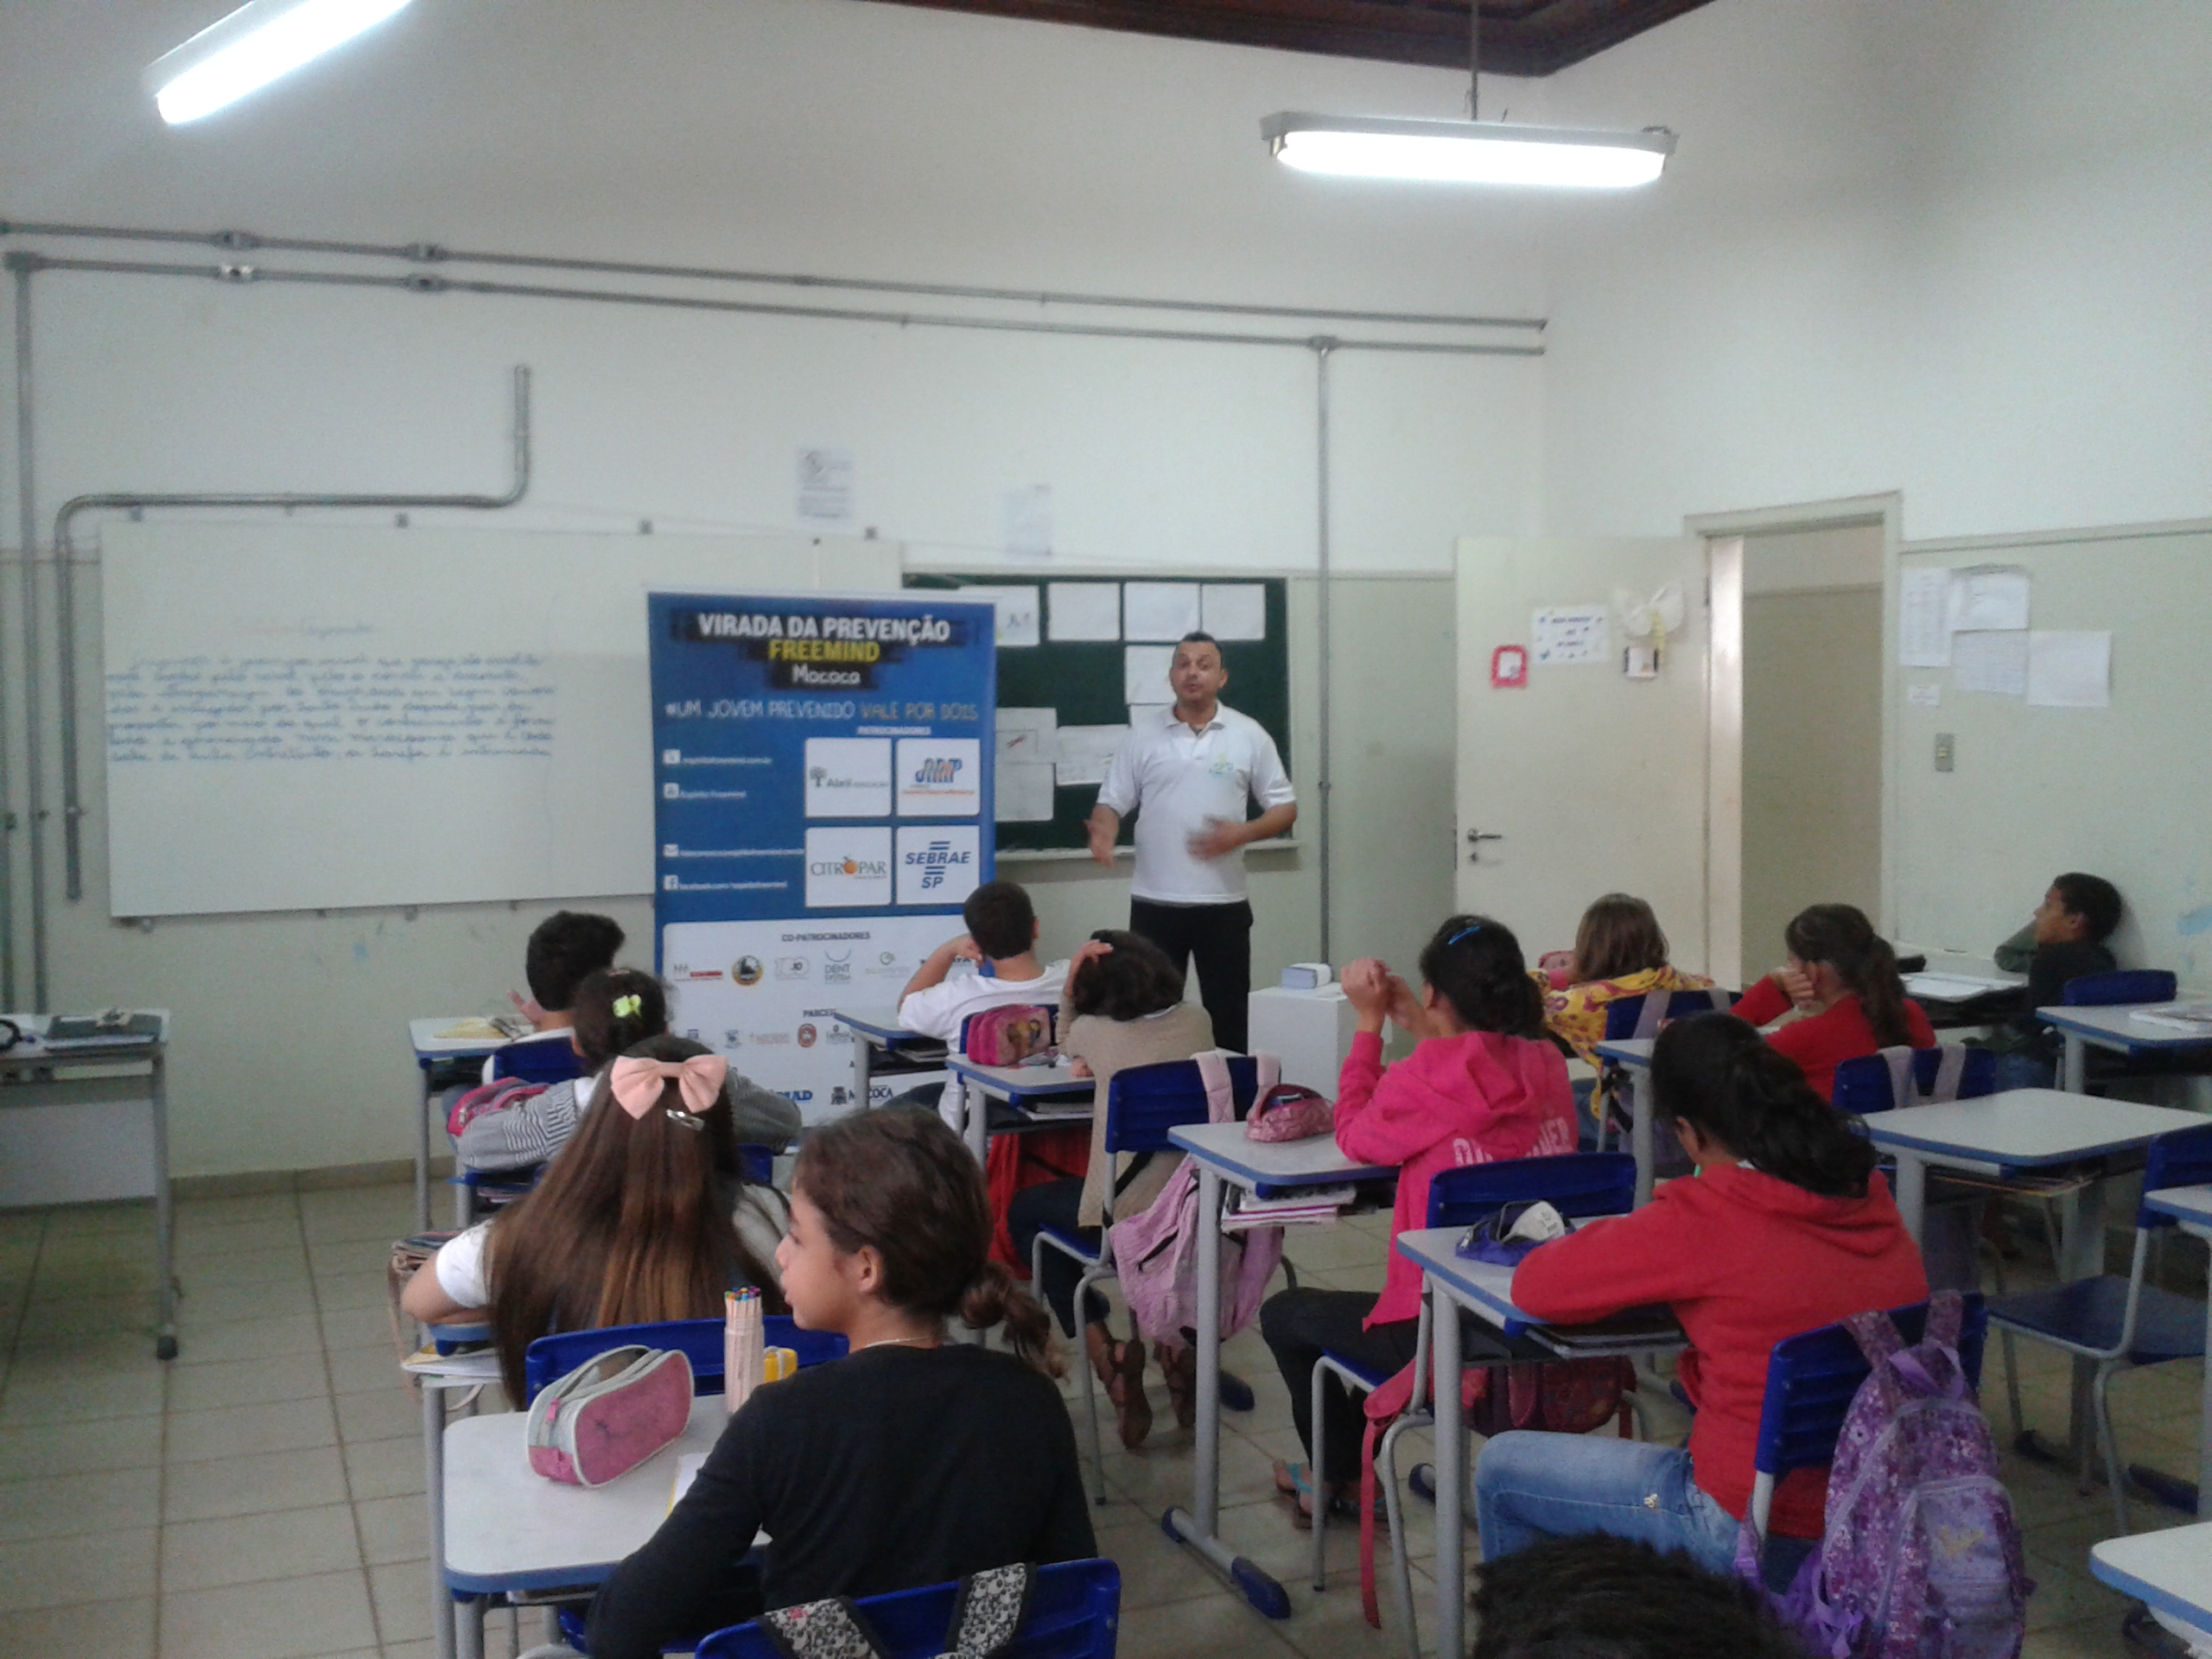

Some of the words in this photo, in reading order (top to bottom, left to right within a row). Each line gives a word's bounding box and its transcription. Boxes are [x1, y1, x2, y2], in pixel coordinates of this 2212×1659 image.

[698, 612, 783, 638] VIRADA
[787, 616, 819, 638] DA
[823, 614, 950, 646] PREVENÇÃO
[768, 639, 880, 663] FREEMIND
[708, 699, 764, 719] JOVEM
[768, 701, 855, 720] PREVENIDO
[861, 702, 899, 720] VALE
[906, 702, 936, 721] POR
[940, 703, 978, 721] DOIS
[906, 851, 971, 865] SEBRAE
[921, 876, 944, 889] SP
[781, 931, 871, 942] CO-PATROCINADORES
